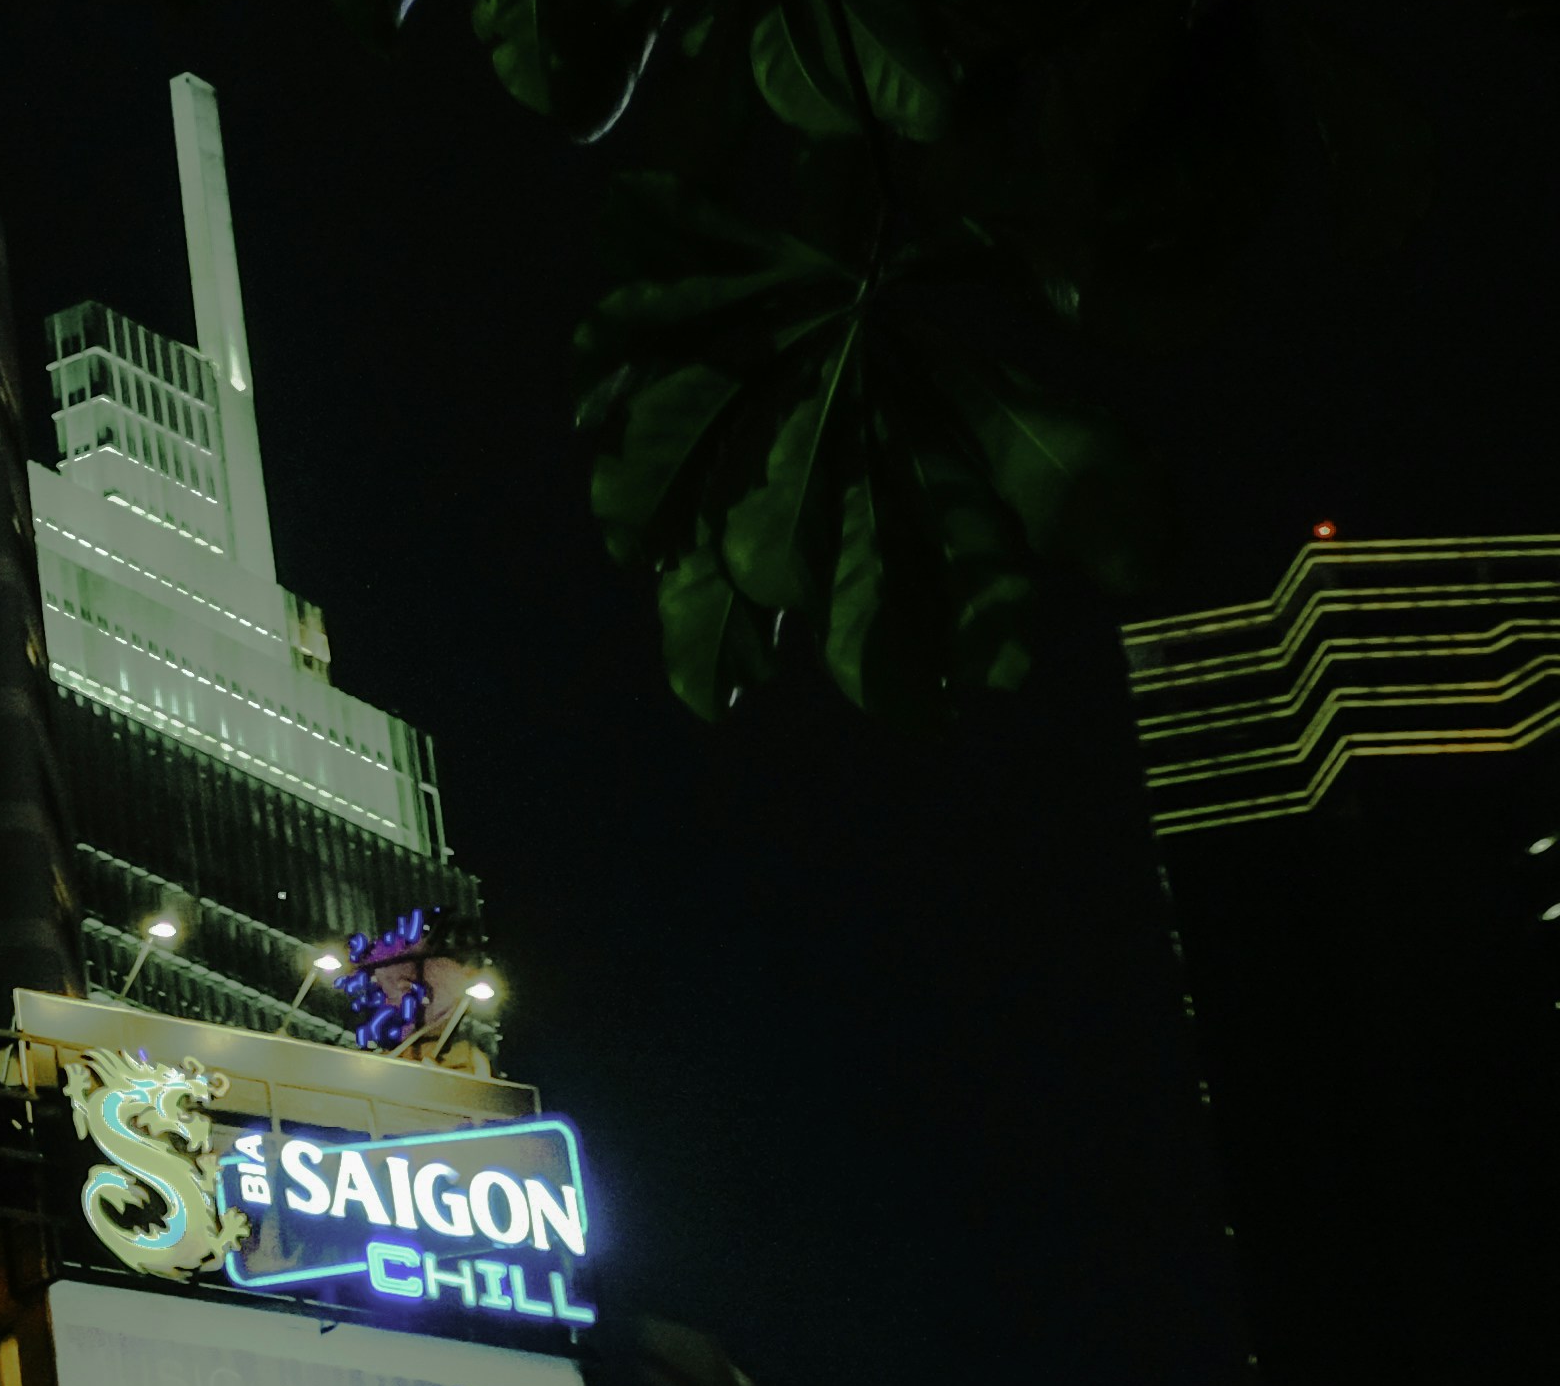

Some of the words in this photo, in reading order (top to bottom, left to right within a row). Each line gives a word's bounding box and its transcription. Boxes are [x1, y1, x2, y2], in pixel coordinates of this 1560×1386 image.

[234, 1133, 272, 1206] BIA
[279, 1138, 587, 1257] SAIGON
[366, 1240, 598, 1326] CHILL
